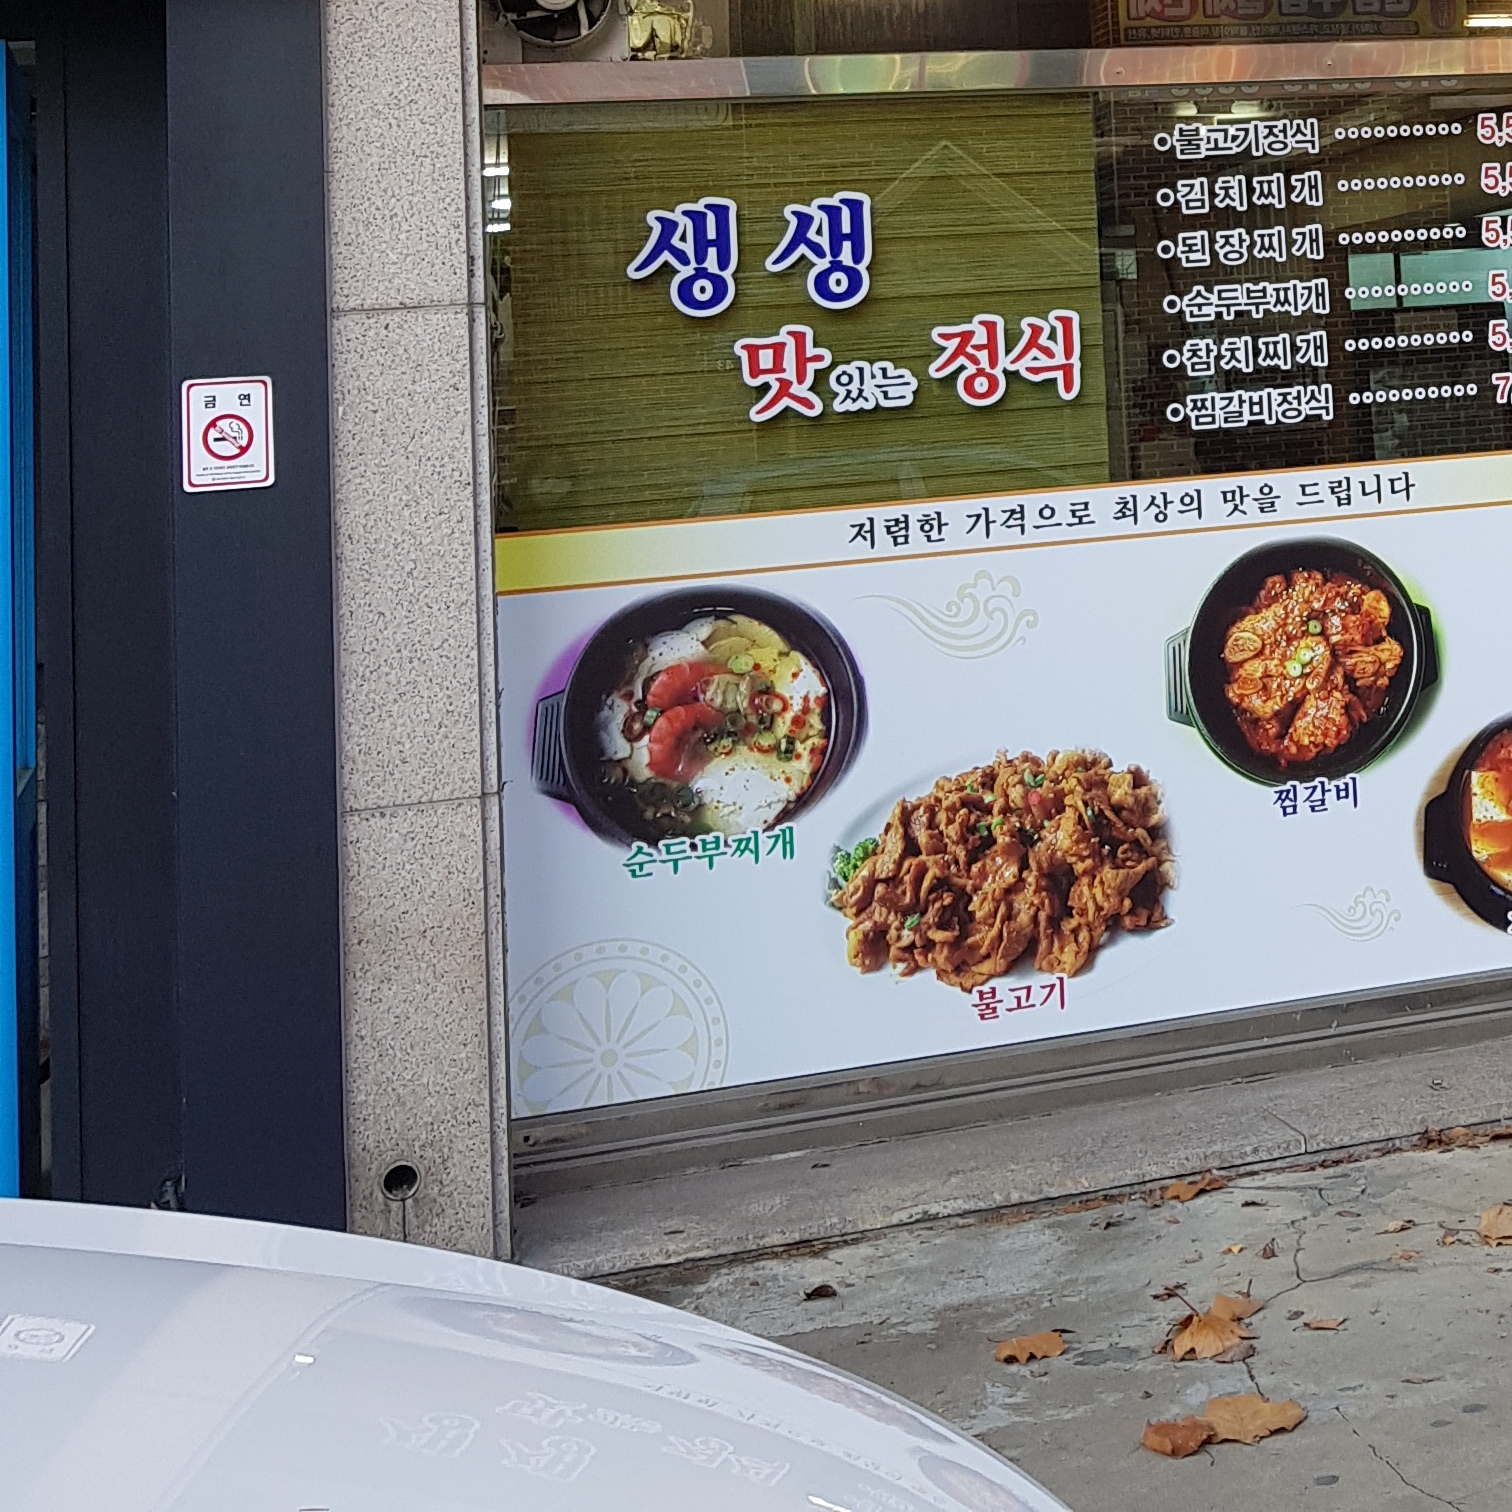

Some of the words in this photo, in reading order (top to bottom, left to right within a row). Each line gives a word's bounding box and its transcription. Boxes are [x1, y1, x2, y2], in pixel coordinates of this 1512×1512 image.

[1174, 119, 1320, 159] 불고기정식
[1177, 171, 1324, 214] 김치찌개
[627, 191, 871, 317] 생생
[1177, 224, 1325, 266] 된장찌개
[1182, 278, 1330, 320] 순두부찌개
[928, 309, 1081, 406] 정식
[1186, 384, 1334, 430] 찜갈비정식
[847, 510, 950, 551] 저렴한
[964, 500, 1097, 540] 가격으로
[1111, 487, 1204, 527] 최상의
[1220, 481, 1282, 517] 맛을
[1294, 471, 1416, 508] 드립니다
[1271, 775, 1360, 817] 찜갈비
[621, 825, 797, 880] 순두부찌개
[969, 975, 1069, 1022] 불고기
